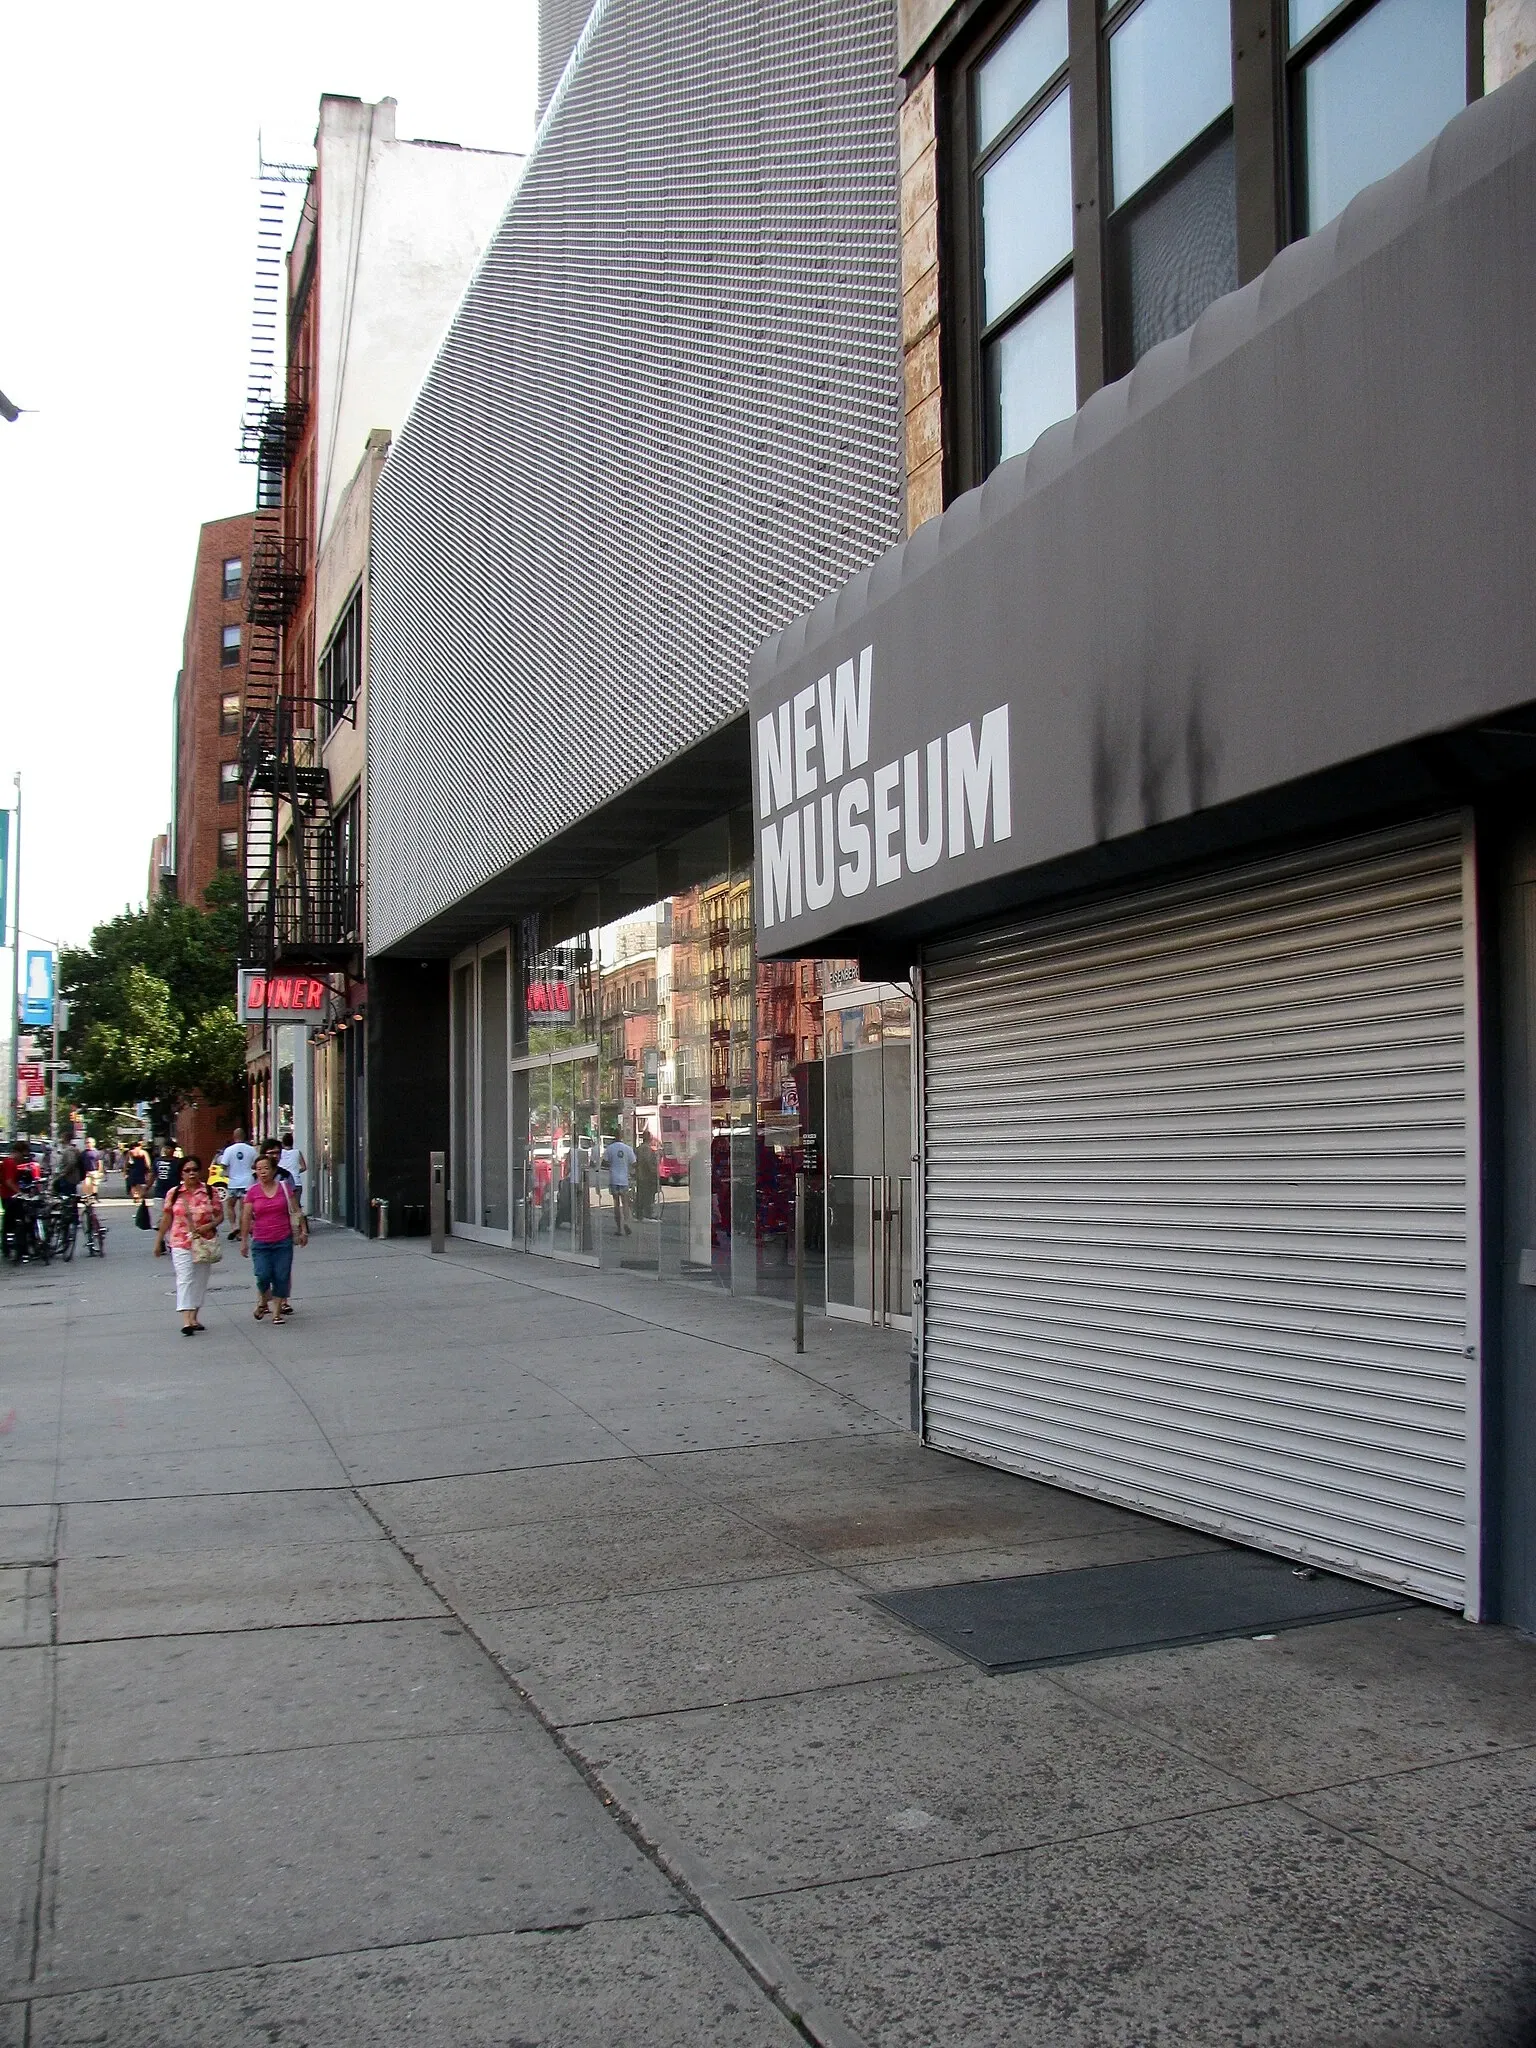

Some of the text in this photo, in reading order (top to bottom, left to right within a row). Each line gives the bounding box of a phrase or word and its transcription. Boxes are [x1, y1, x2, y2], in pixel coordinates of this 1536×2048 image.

[757, 644, 873, 819] NEW
[761, 703, 1012, 929] MUSEUM
[247, 977, 324, 1010] DINER
